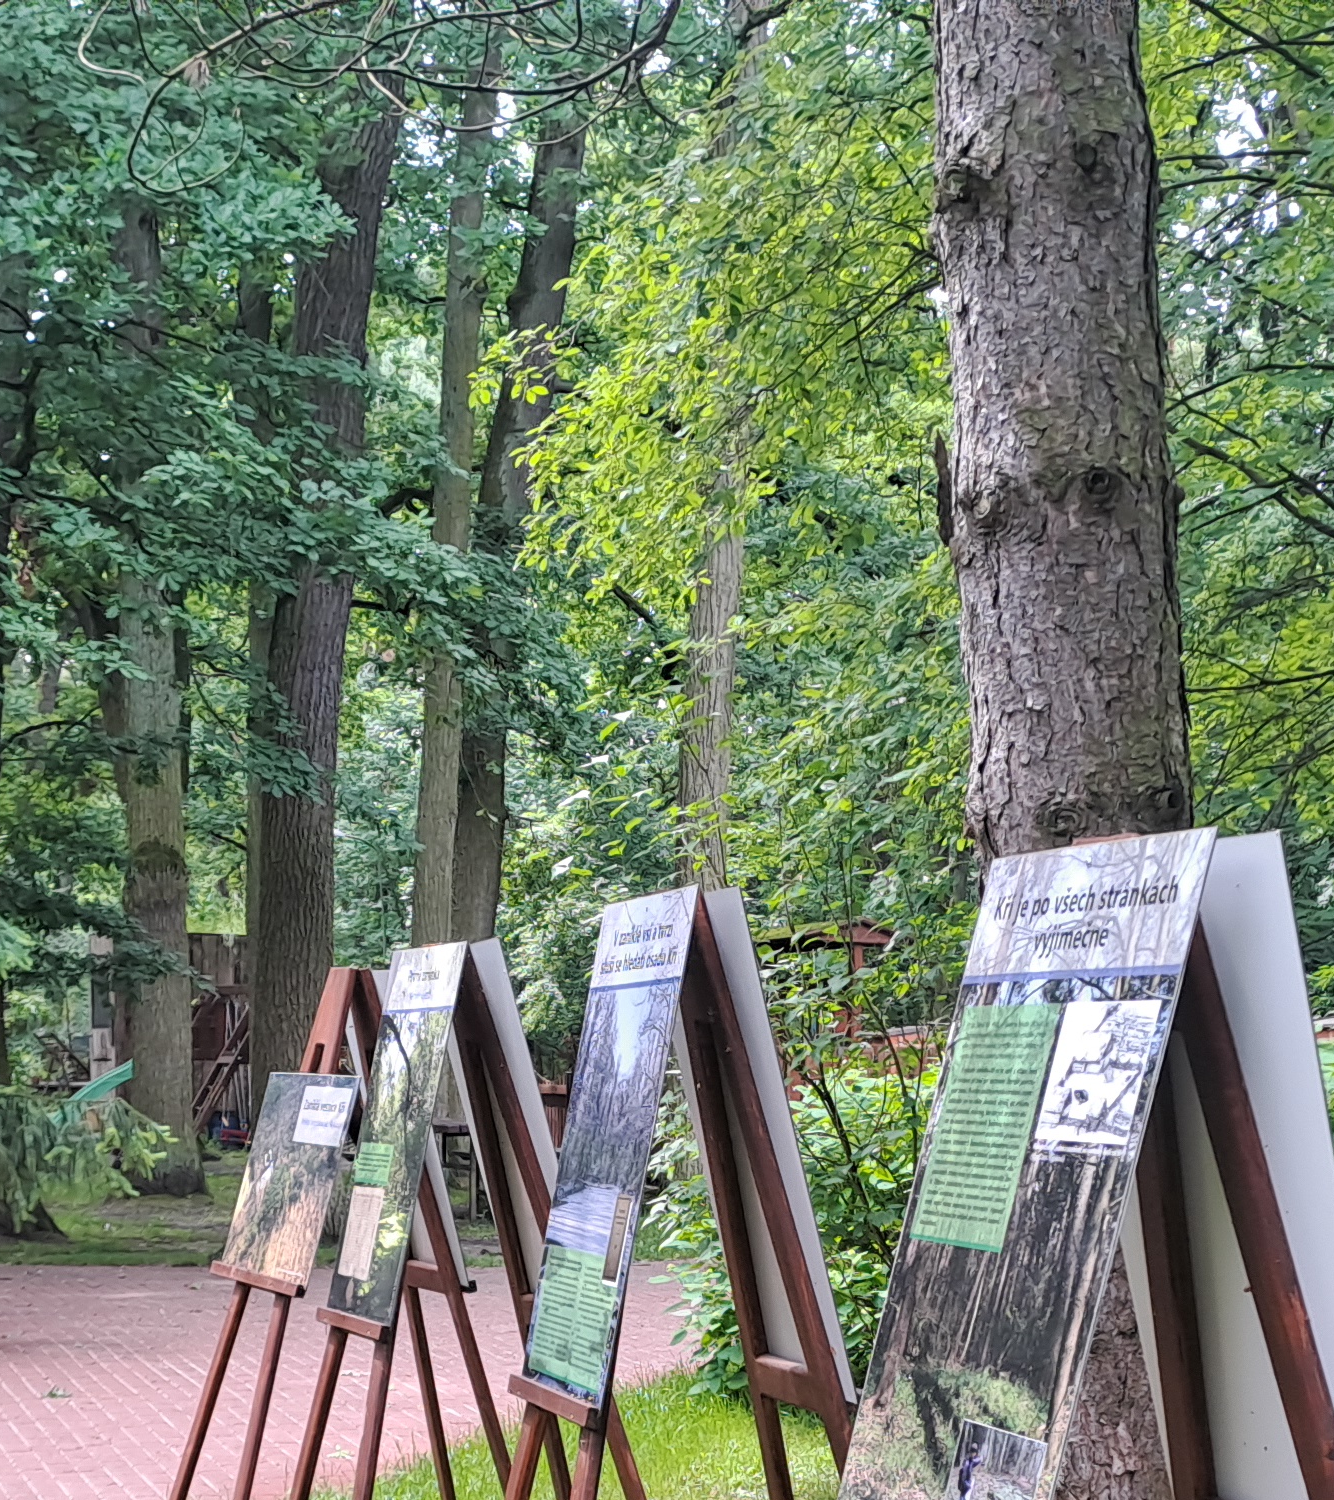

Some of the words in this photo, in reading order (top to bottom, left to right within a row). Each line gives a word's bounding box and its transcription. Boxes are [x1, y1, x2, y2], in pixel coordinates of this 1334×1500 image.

[1029, 896, 1050, 924] po
[1055, 884, 1098, 914] všech
[1098, 875, 1179, 910] stránkách
